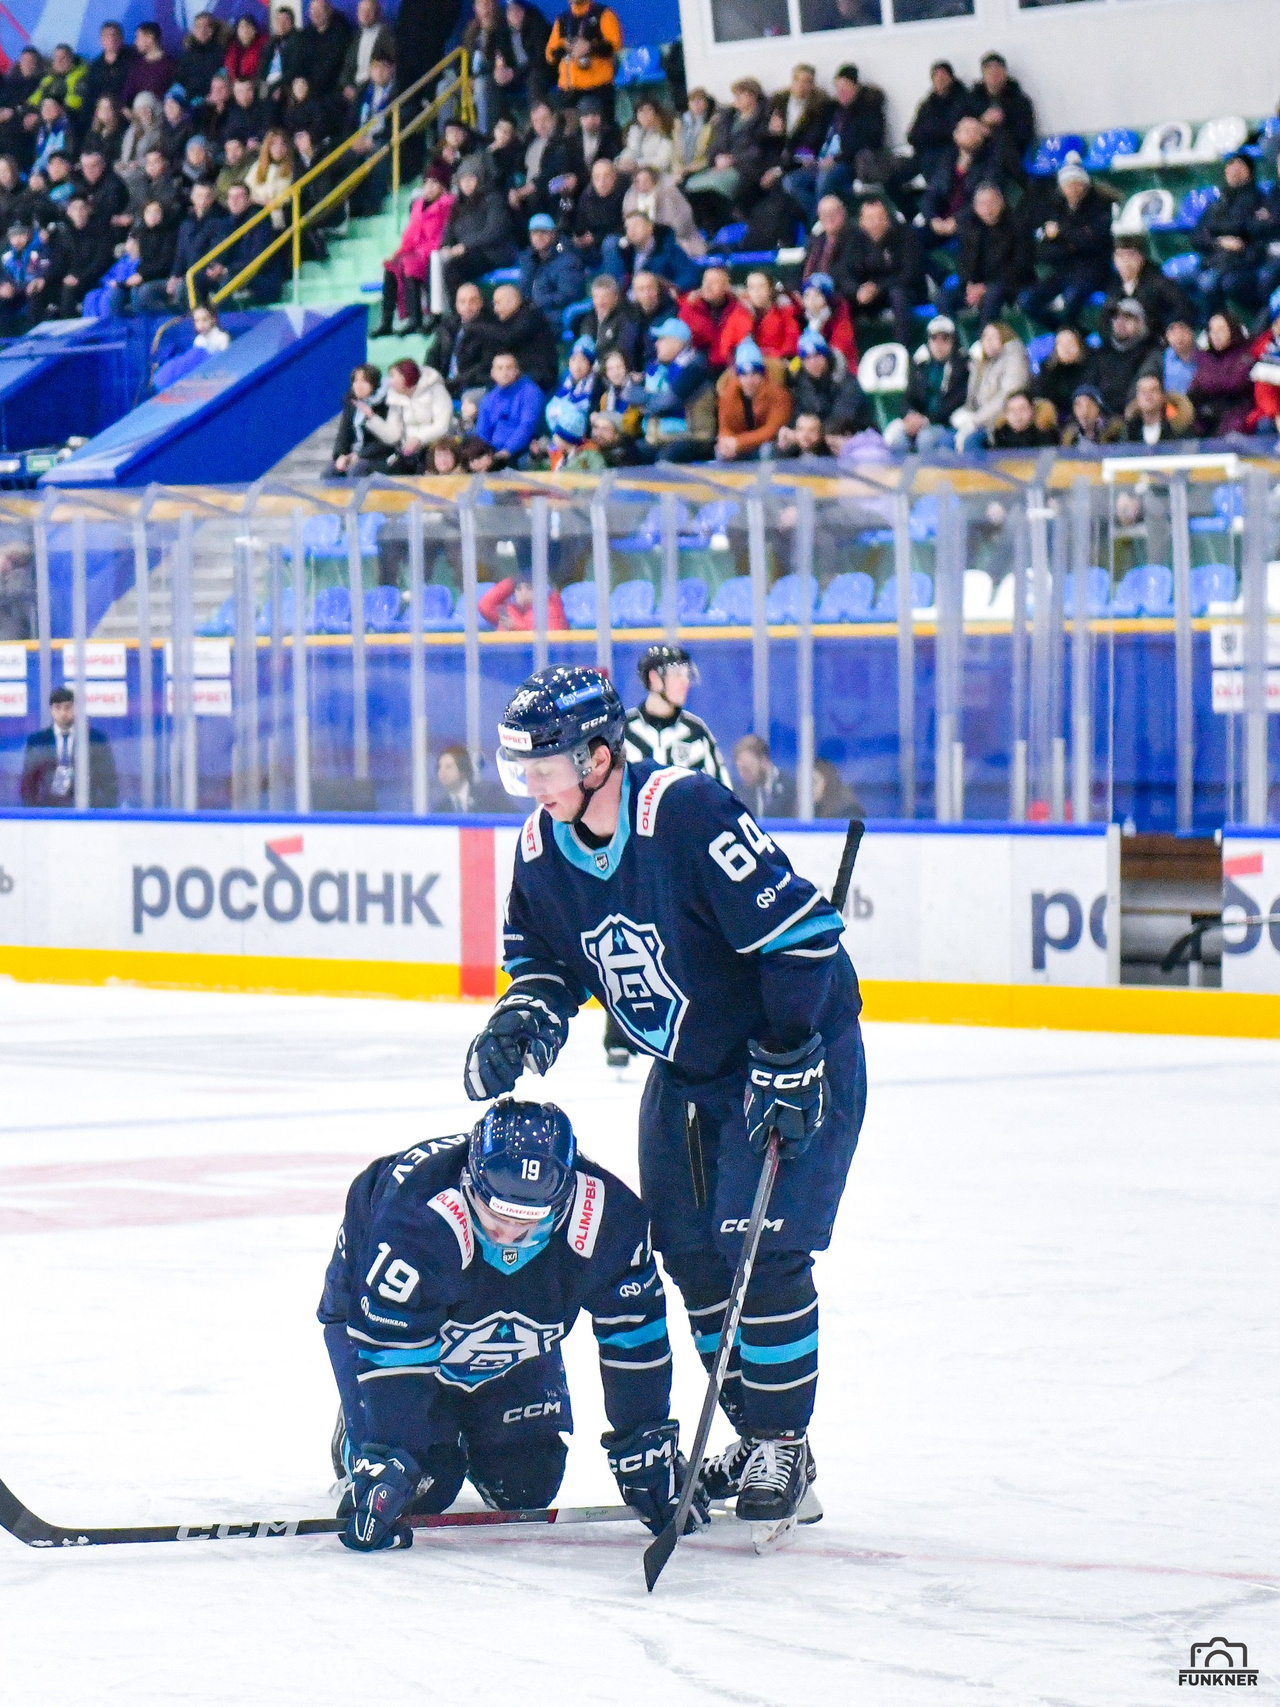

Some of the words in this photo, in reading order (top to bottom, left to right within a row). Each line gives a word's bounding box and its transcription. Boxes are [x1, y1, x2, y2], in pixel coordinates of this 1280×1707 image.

[580, 714, 608, 731] CCM
[708, 811, 776, 882] 64
[131, 835, 443, 934] росбанк
[750, 1059, 826, 1090] CCM
[392, 1134, 467, 1185] AYEV
[521, 1158, 541, 1181] 19
[492, 1202, 548, 1216] OLIMPBET
[436, 1192, 472, 1260] OLIMPBET
[365, 1241, 420, 1304] 19
[502, 1400, 562, 1424] CCM
[176, 1519, 301, 1541] CCM
[365, 1517, 376, 1542] CCM
